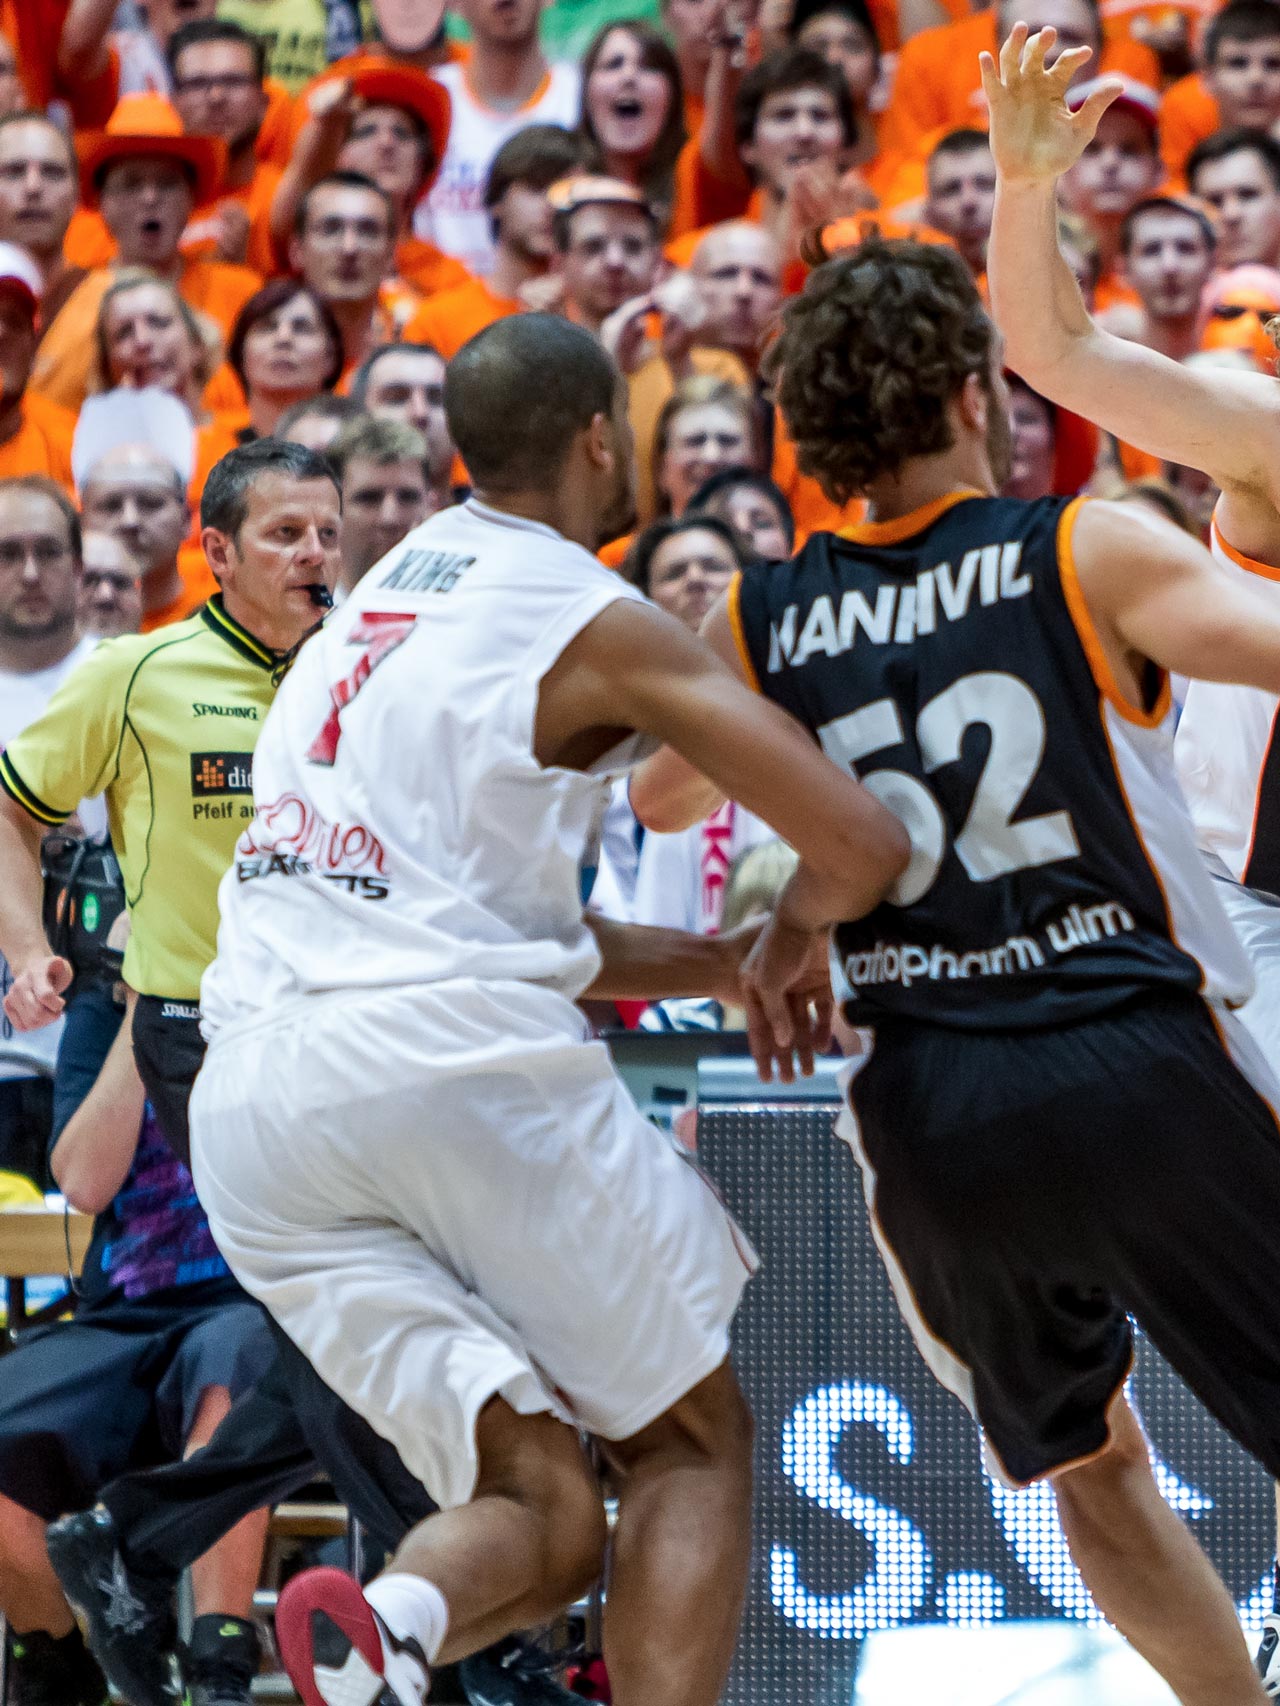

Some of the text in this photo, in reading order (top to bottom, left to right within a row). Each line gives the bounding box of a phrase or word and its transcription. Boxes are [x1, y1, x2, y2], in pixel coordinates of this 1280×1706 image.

[377, 549, 477, 593] KING
[304, 612, 417, 767] 7
[192, 703, 258, 721] SPALDING
[193, 802, 233, 820] Pfeif
[816, 671, 1081, 907] 52
[1045, 902, 1135, 953] ulm
[161, 1003, 204, 1019] SPALD
